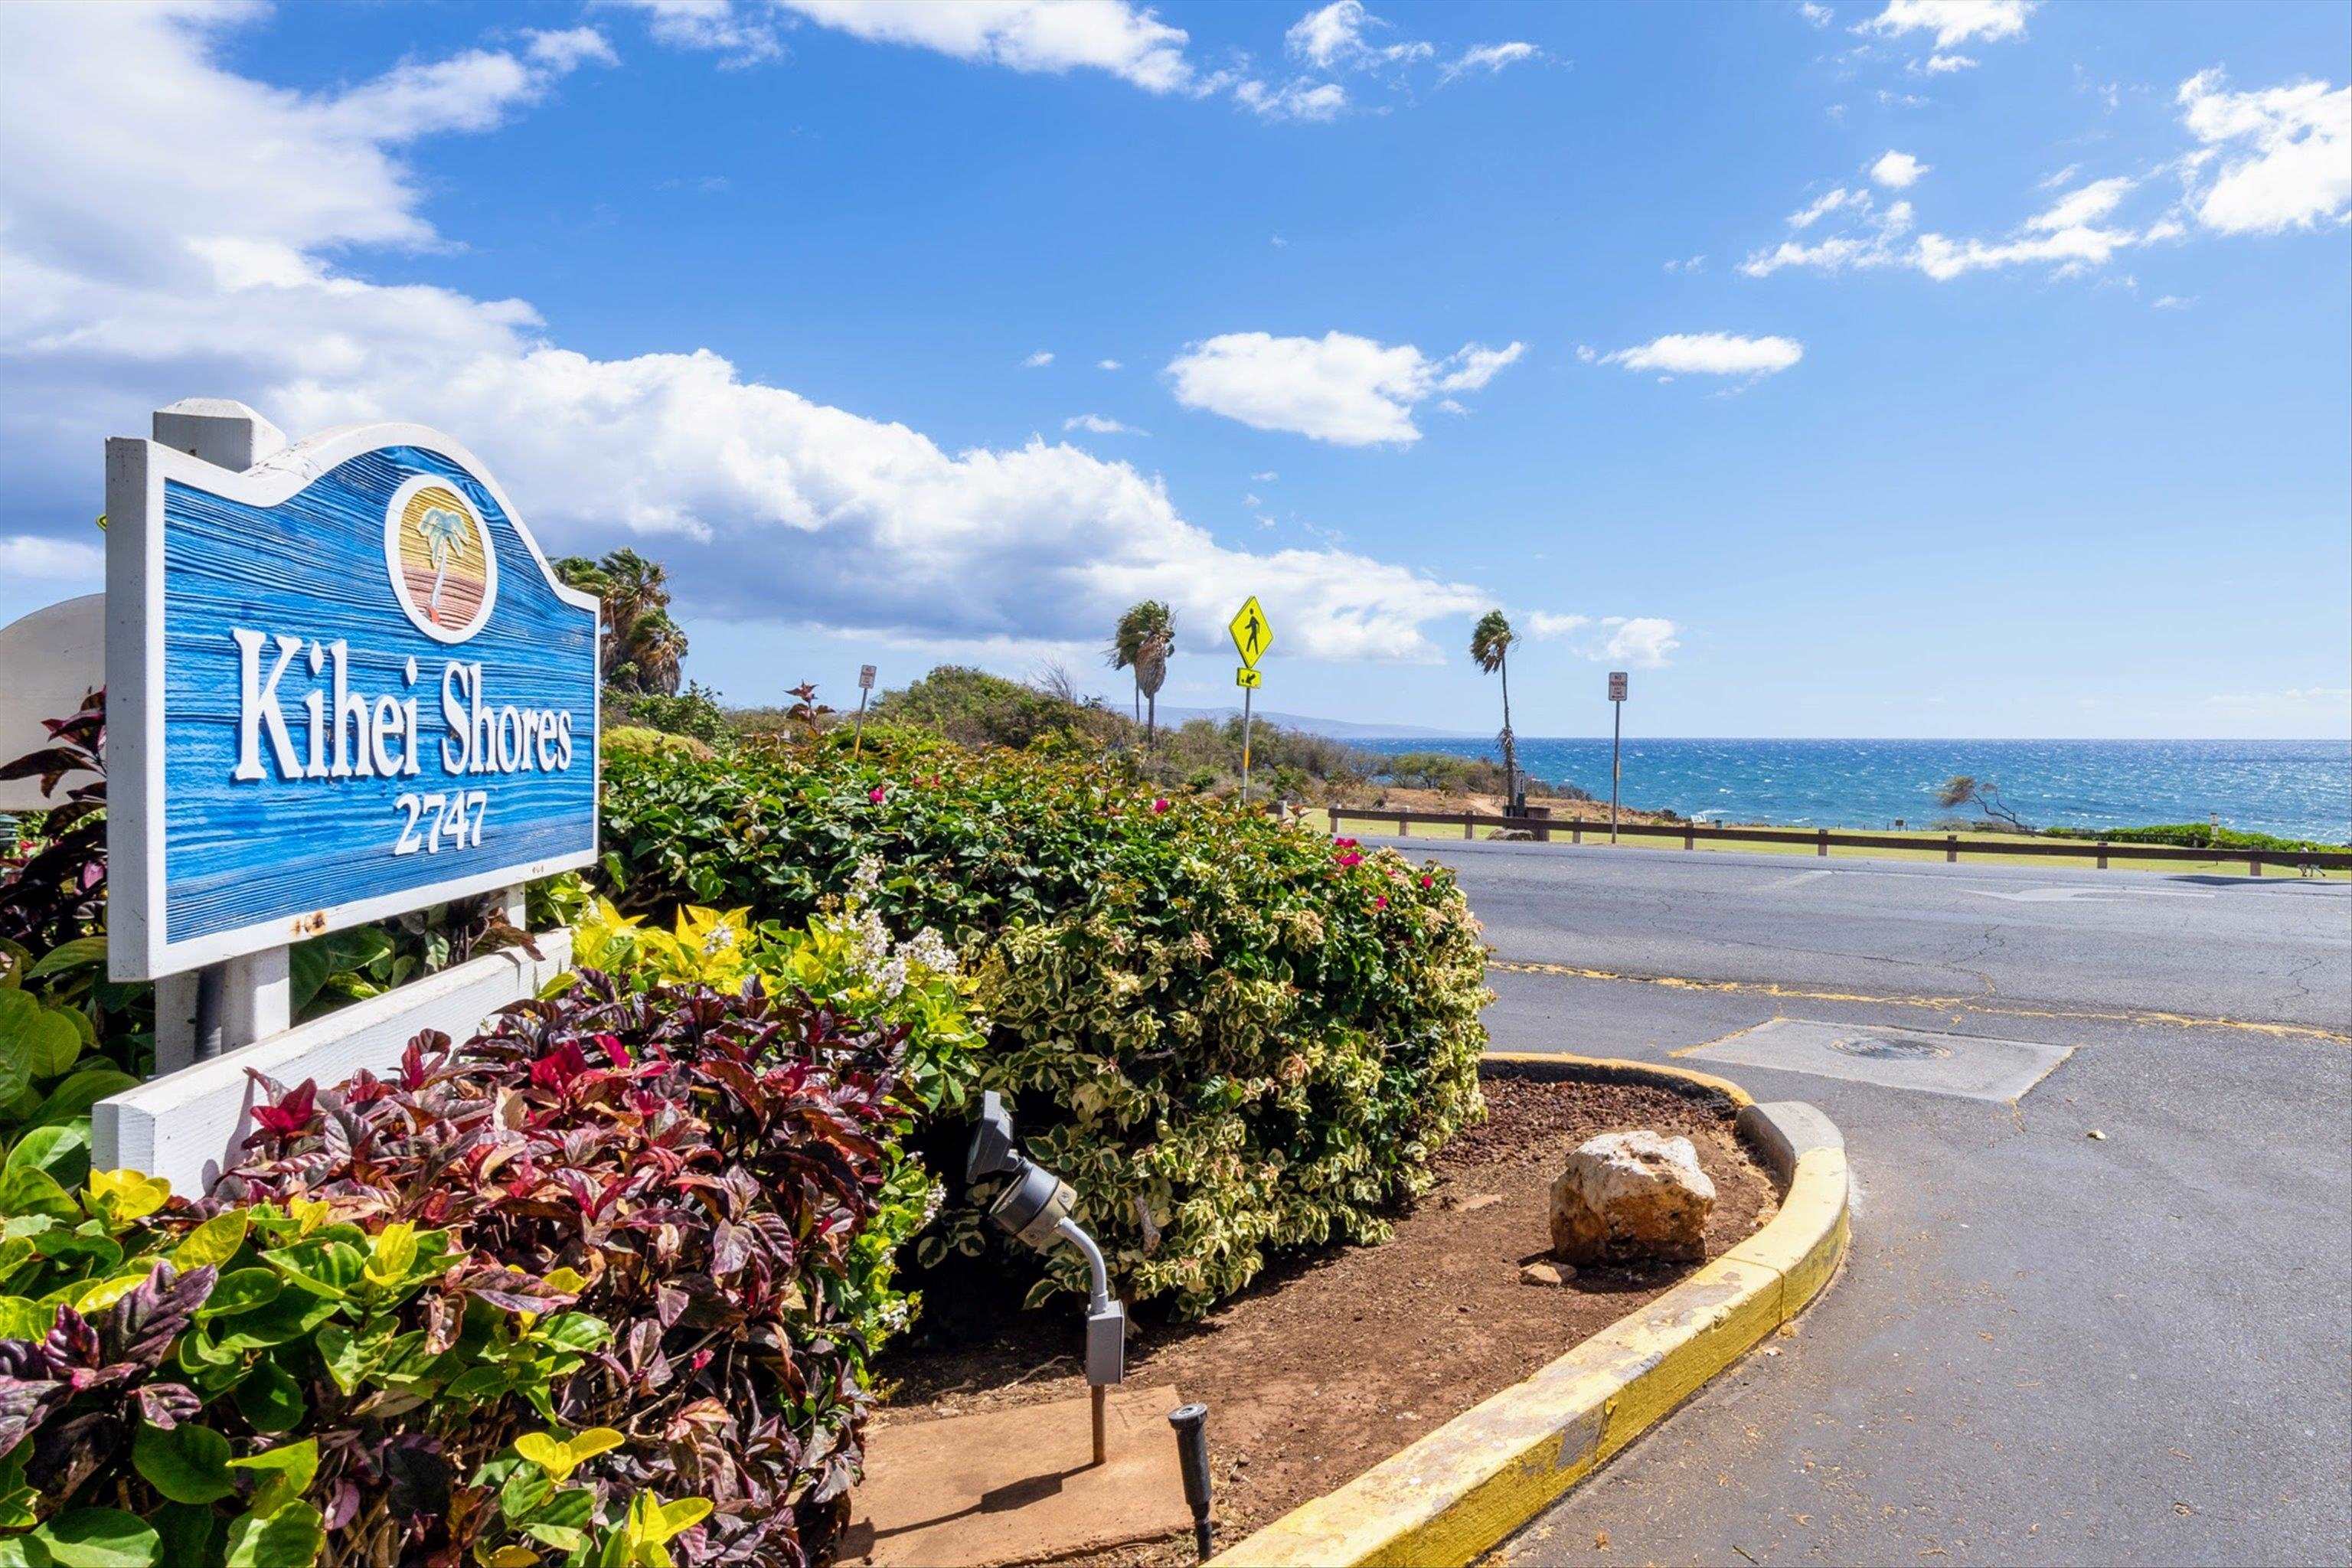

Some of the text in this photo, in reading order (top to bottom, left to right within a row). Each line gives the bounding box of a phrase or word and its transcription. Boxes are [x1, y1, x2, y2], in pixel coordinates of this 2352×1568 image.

[233, 629, 572, 779] Kihei Shores
[394, 790, 488, 856] 2747
